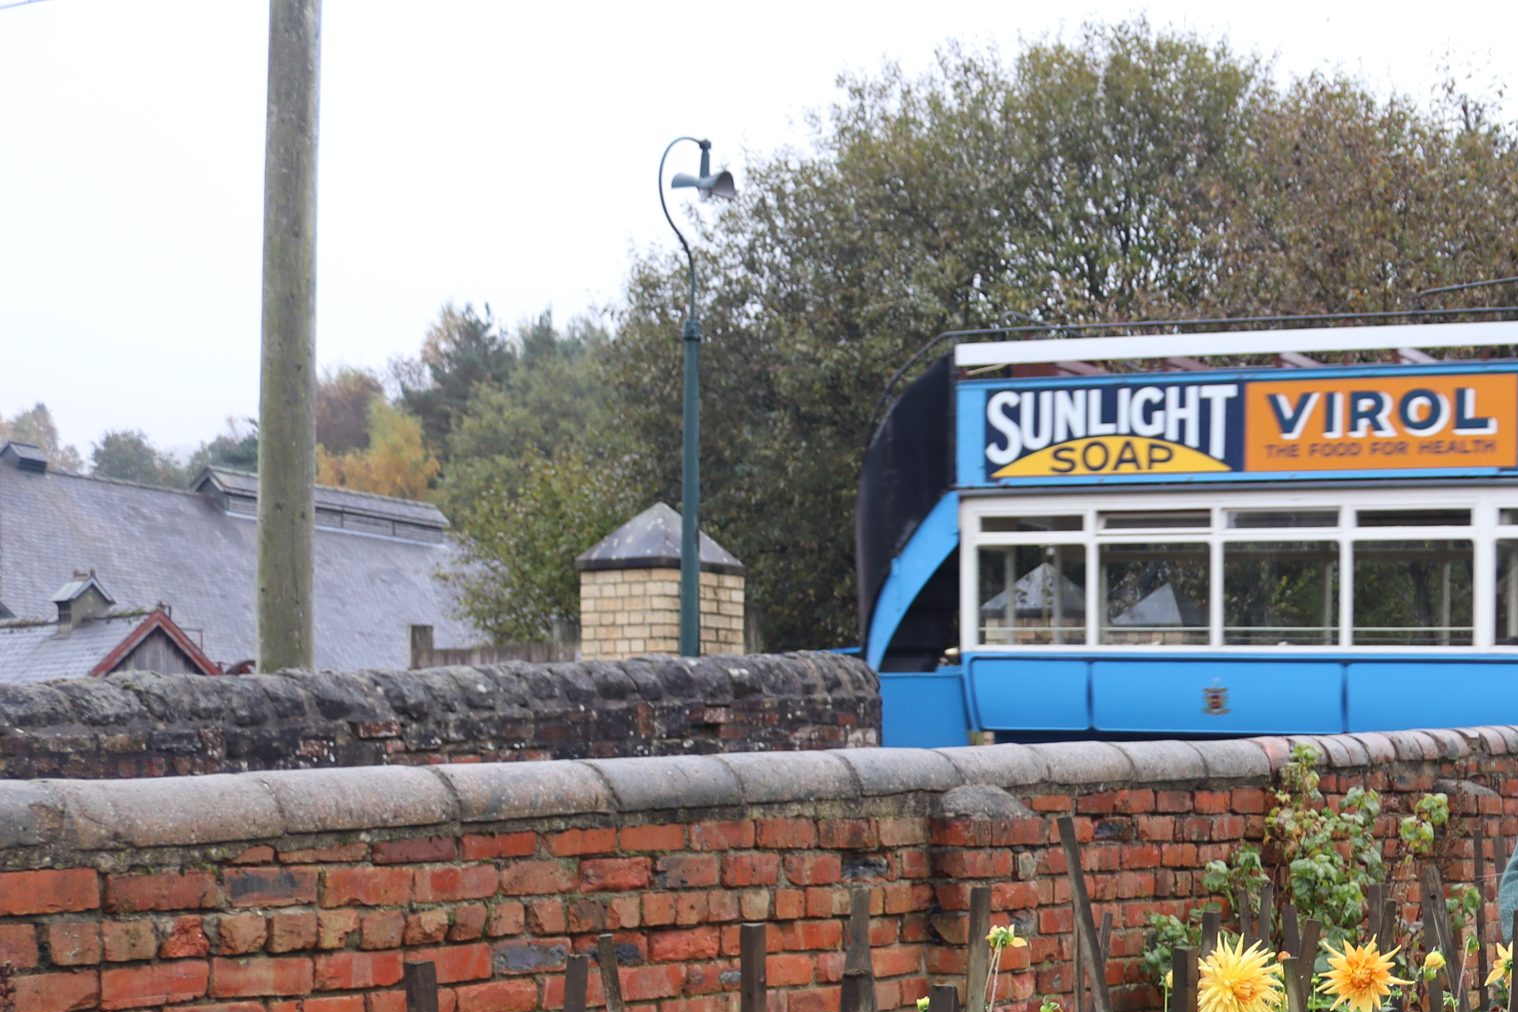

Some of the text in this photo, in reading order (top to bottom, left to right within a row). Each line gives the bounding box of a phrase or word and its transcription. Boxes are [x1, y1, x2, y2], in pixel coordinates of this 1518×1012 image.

[985, 384, 1239, 466] SUNLIGHT
[1266, 387, 1498, 441] VIROL
[1050, 440, 1175, 473] SOAP
[1265, 438, 1497, 458] THE FOOD FOR HEALTH
